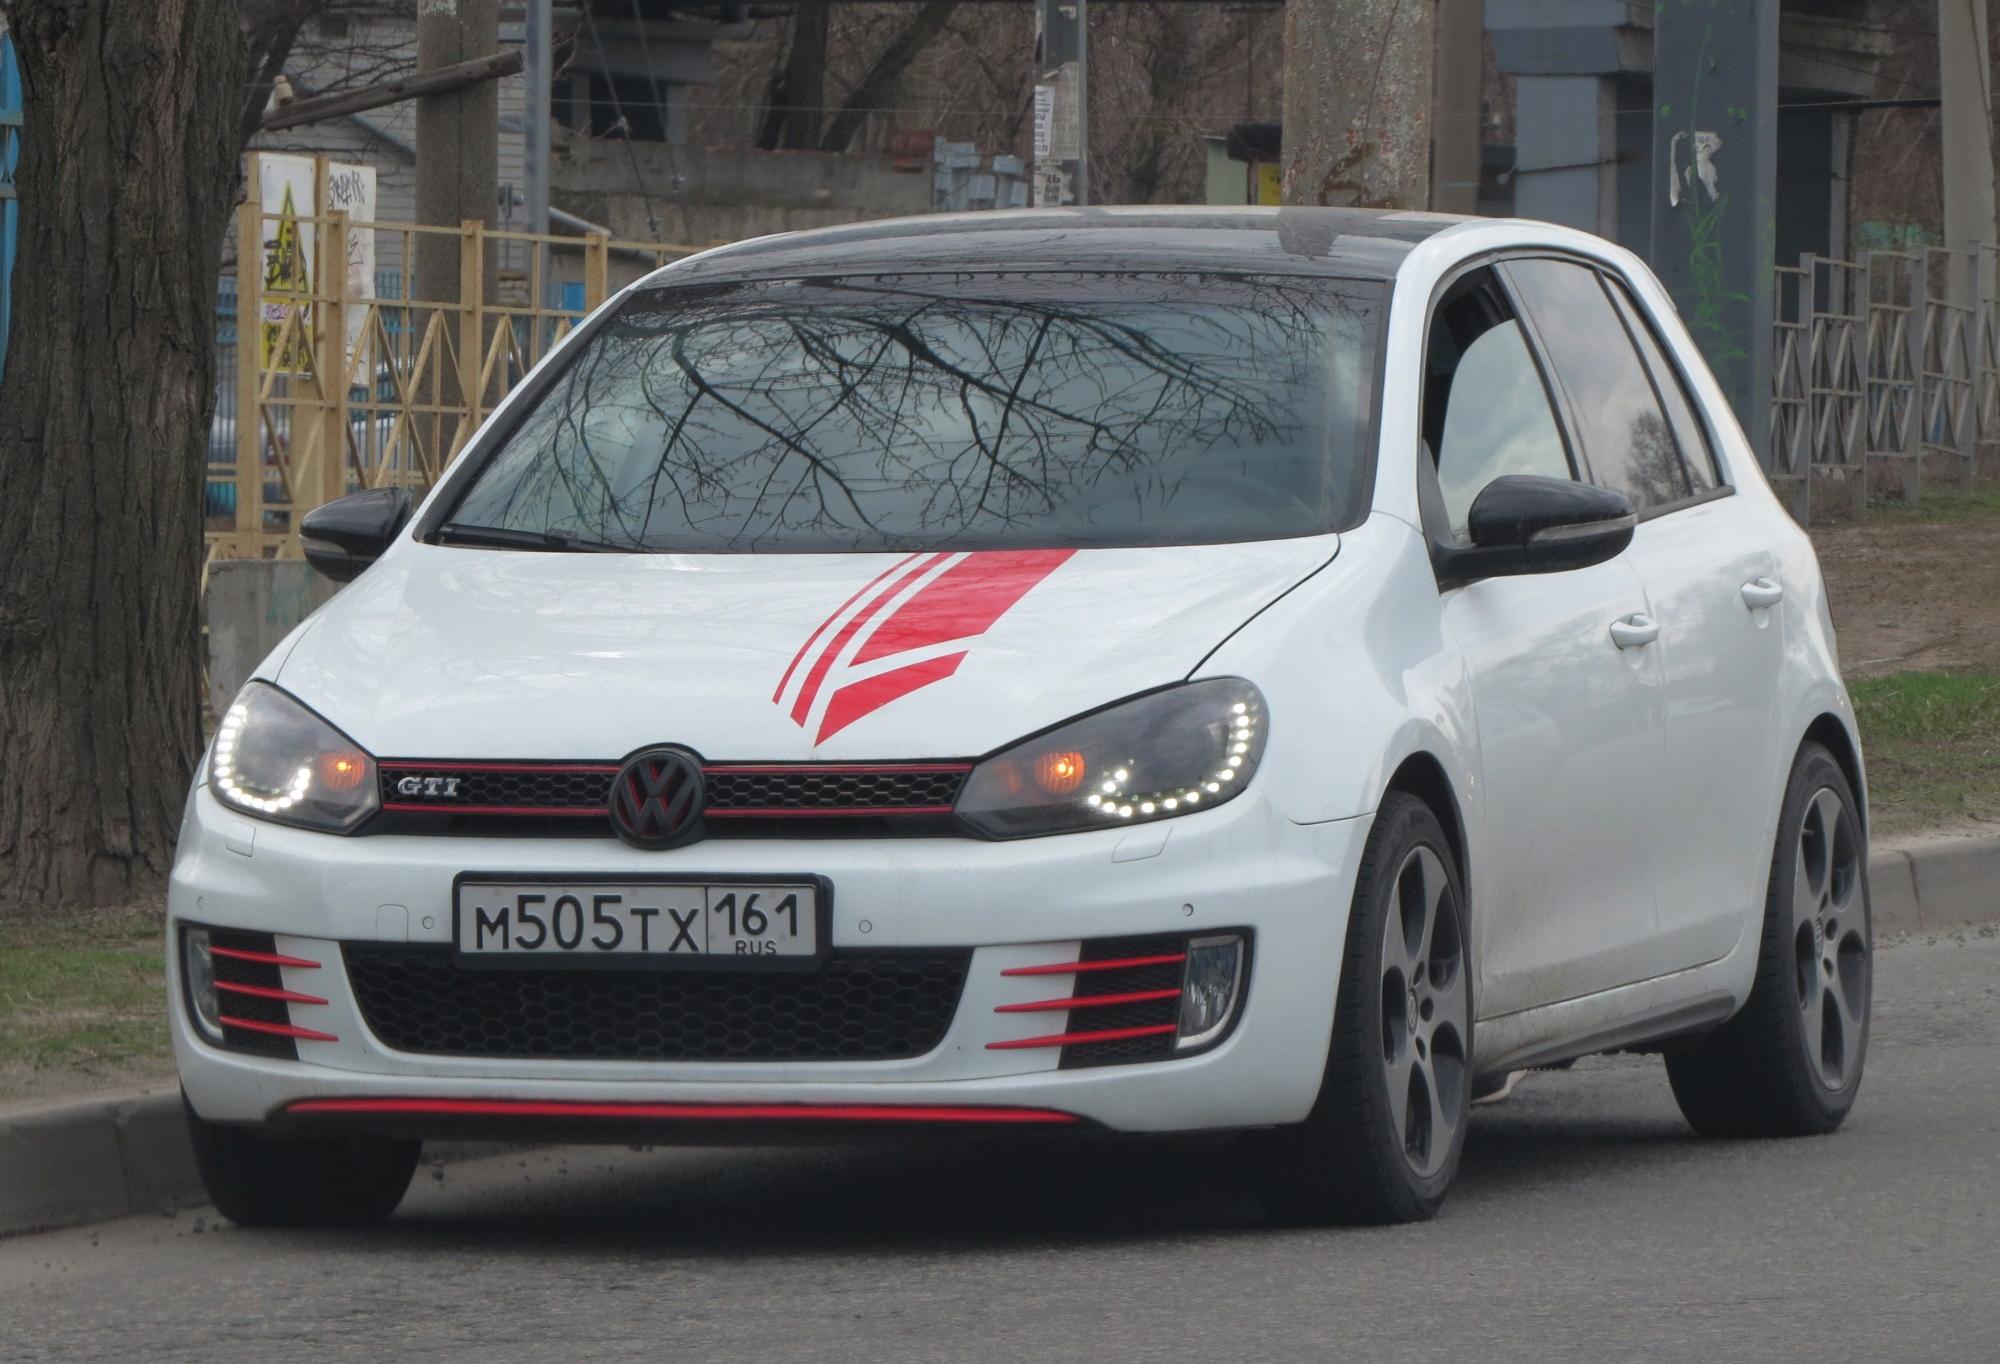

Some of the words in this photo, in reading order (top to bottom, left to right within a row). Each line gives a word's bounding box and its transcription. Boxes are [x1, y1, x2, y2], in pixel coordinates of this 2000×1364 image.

[397, 777, 461, 796] GTI
[475, 894, 700, 952] М505ТХ
[713, 892, 798, 937] 161
[735, 939, 777, 955] RUS
